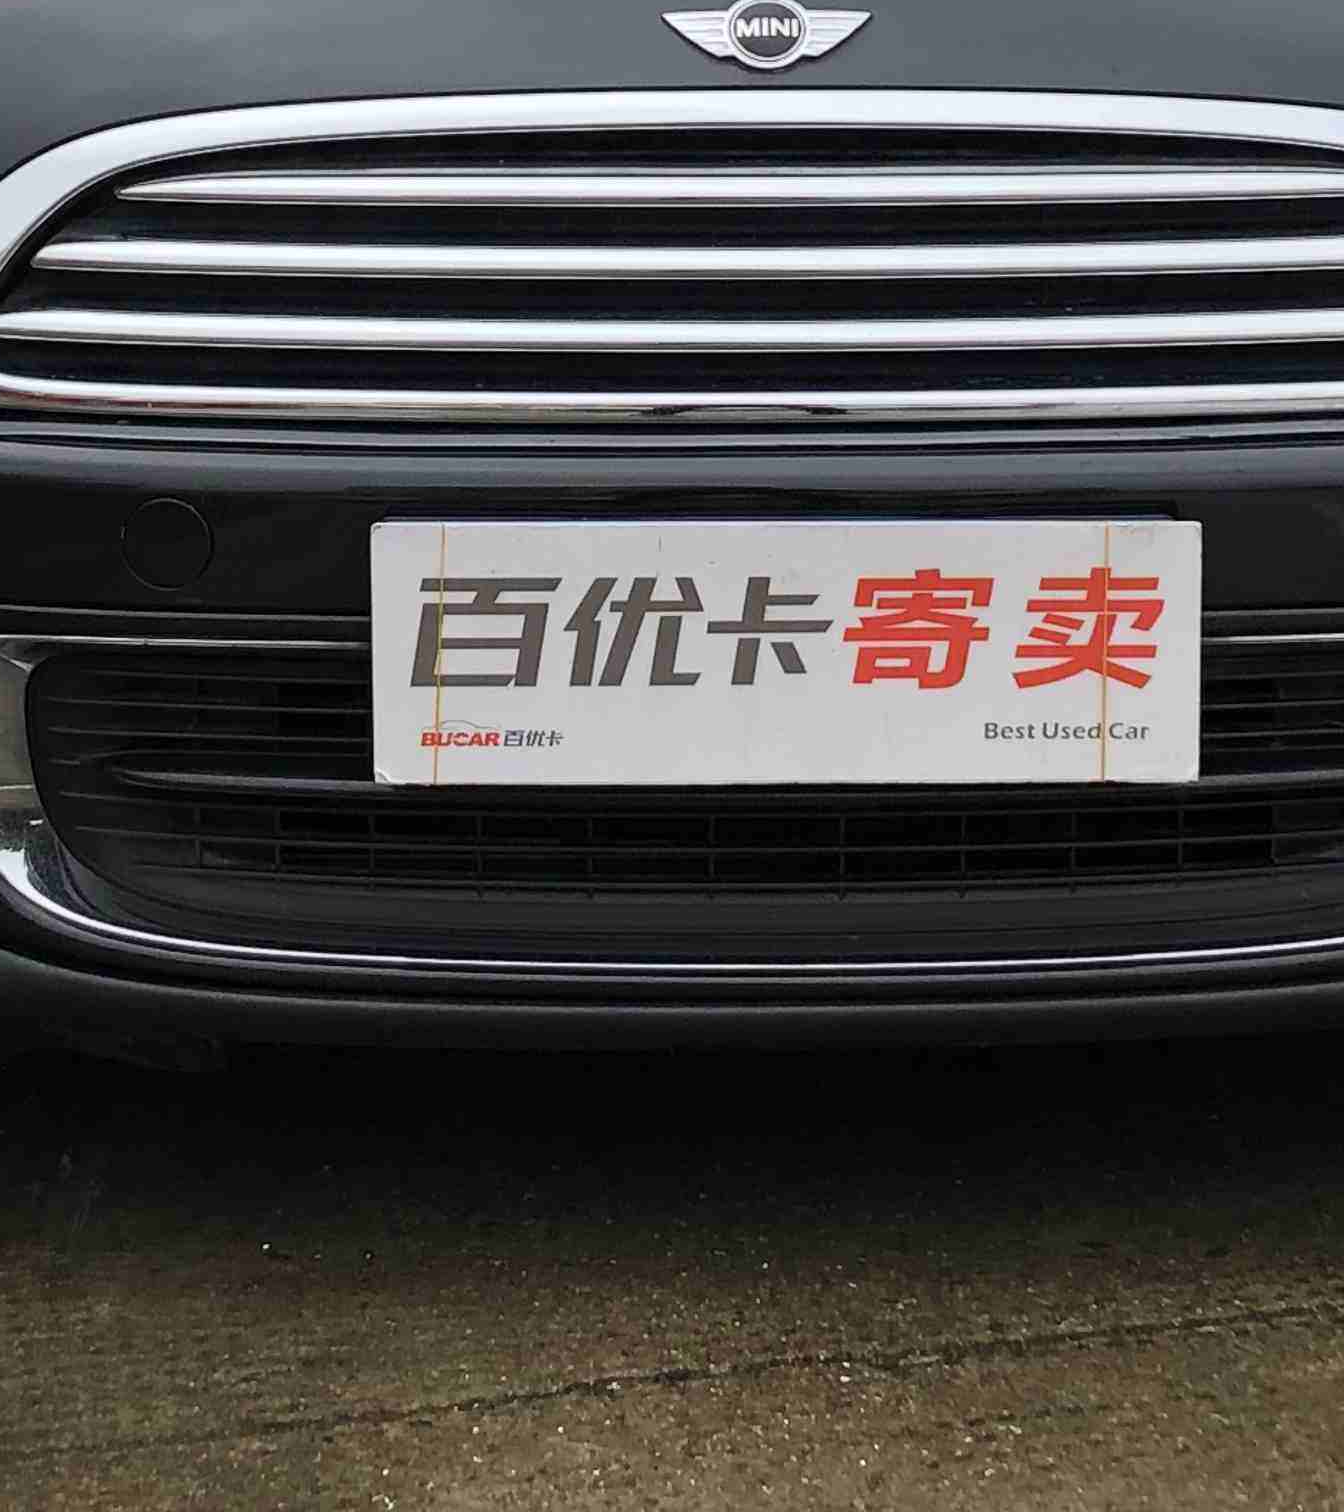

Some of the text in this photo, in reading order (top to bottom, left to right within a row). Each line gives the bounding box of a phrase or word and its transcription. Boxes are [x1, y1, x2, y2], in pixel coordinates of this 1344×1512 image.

[735, 17, 800, 38] MINI
[410, 567, 1166, 691] 百优卡寄卖
[420, 729, 564, 747] BUCAR 百优卡
[983, 721, 1150, 740] Best Used Car
